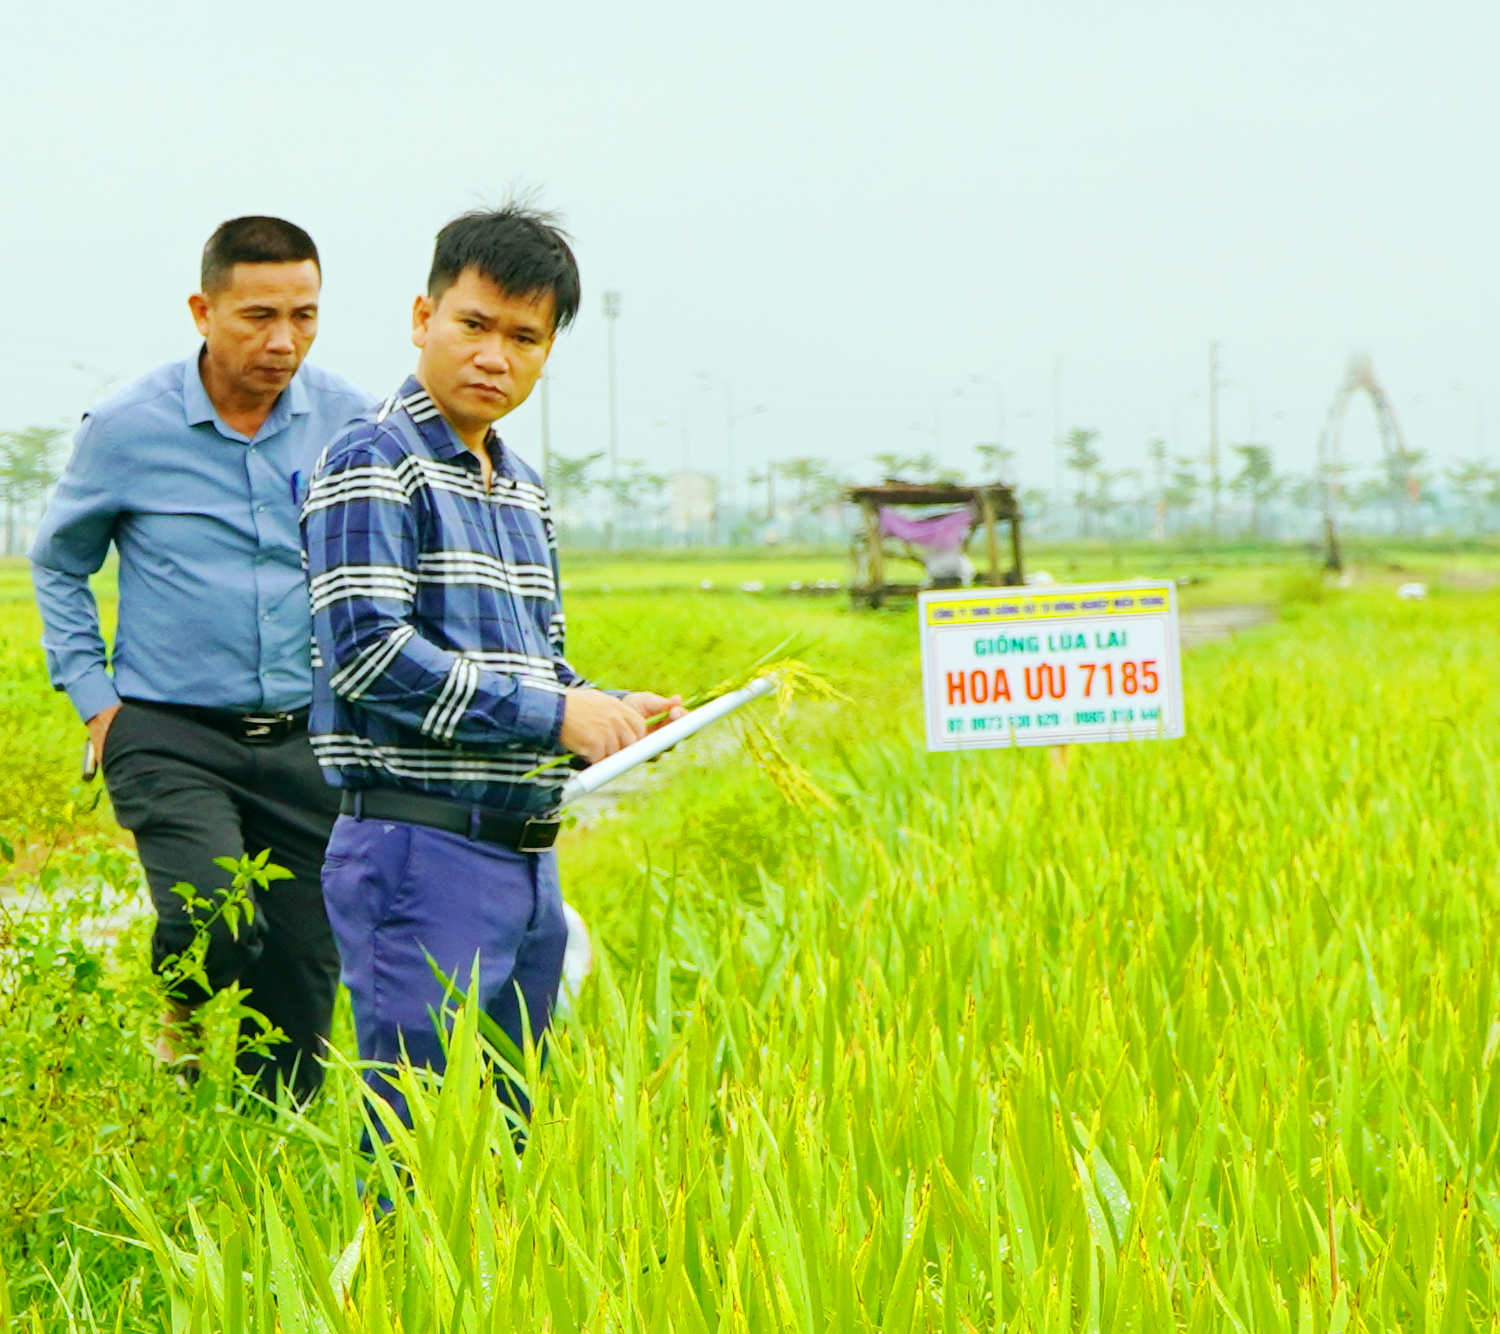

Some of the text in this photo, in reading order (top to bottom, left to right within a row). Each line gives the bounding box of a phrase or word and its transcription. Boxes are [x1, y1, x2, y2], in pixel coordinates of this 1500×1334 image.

[1095, 630, 1128, 650] LAI
[945, 660, 1160, 706] HOA ƯU 7185
